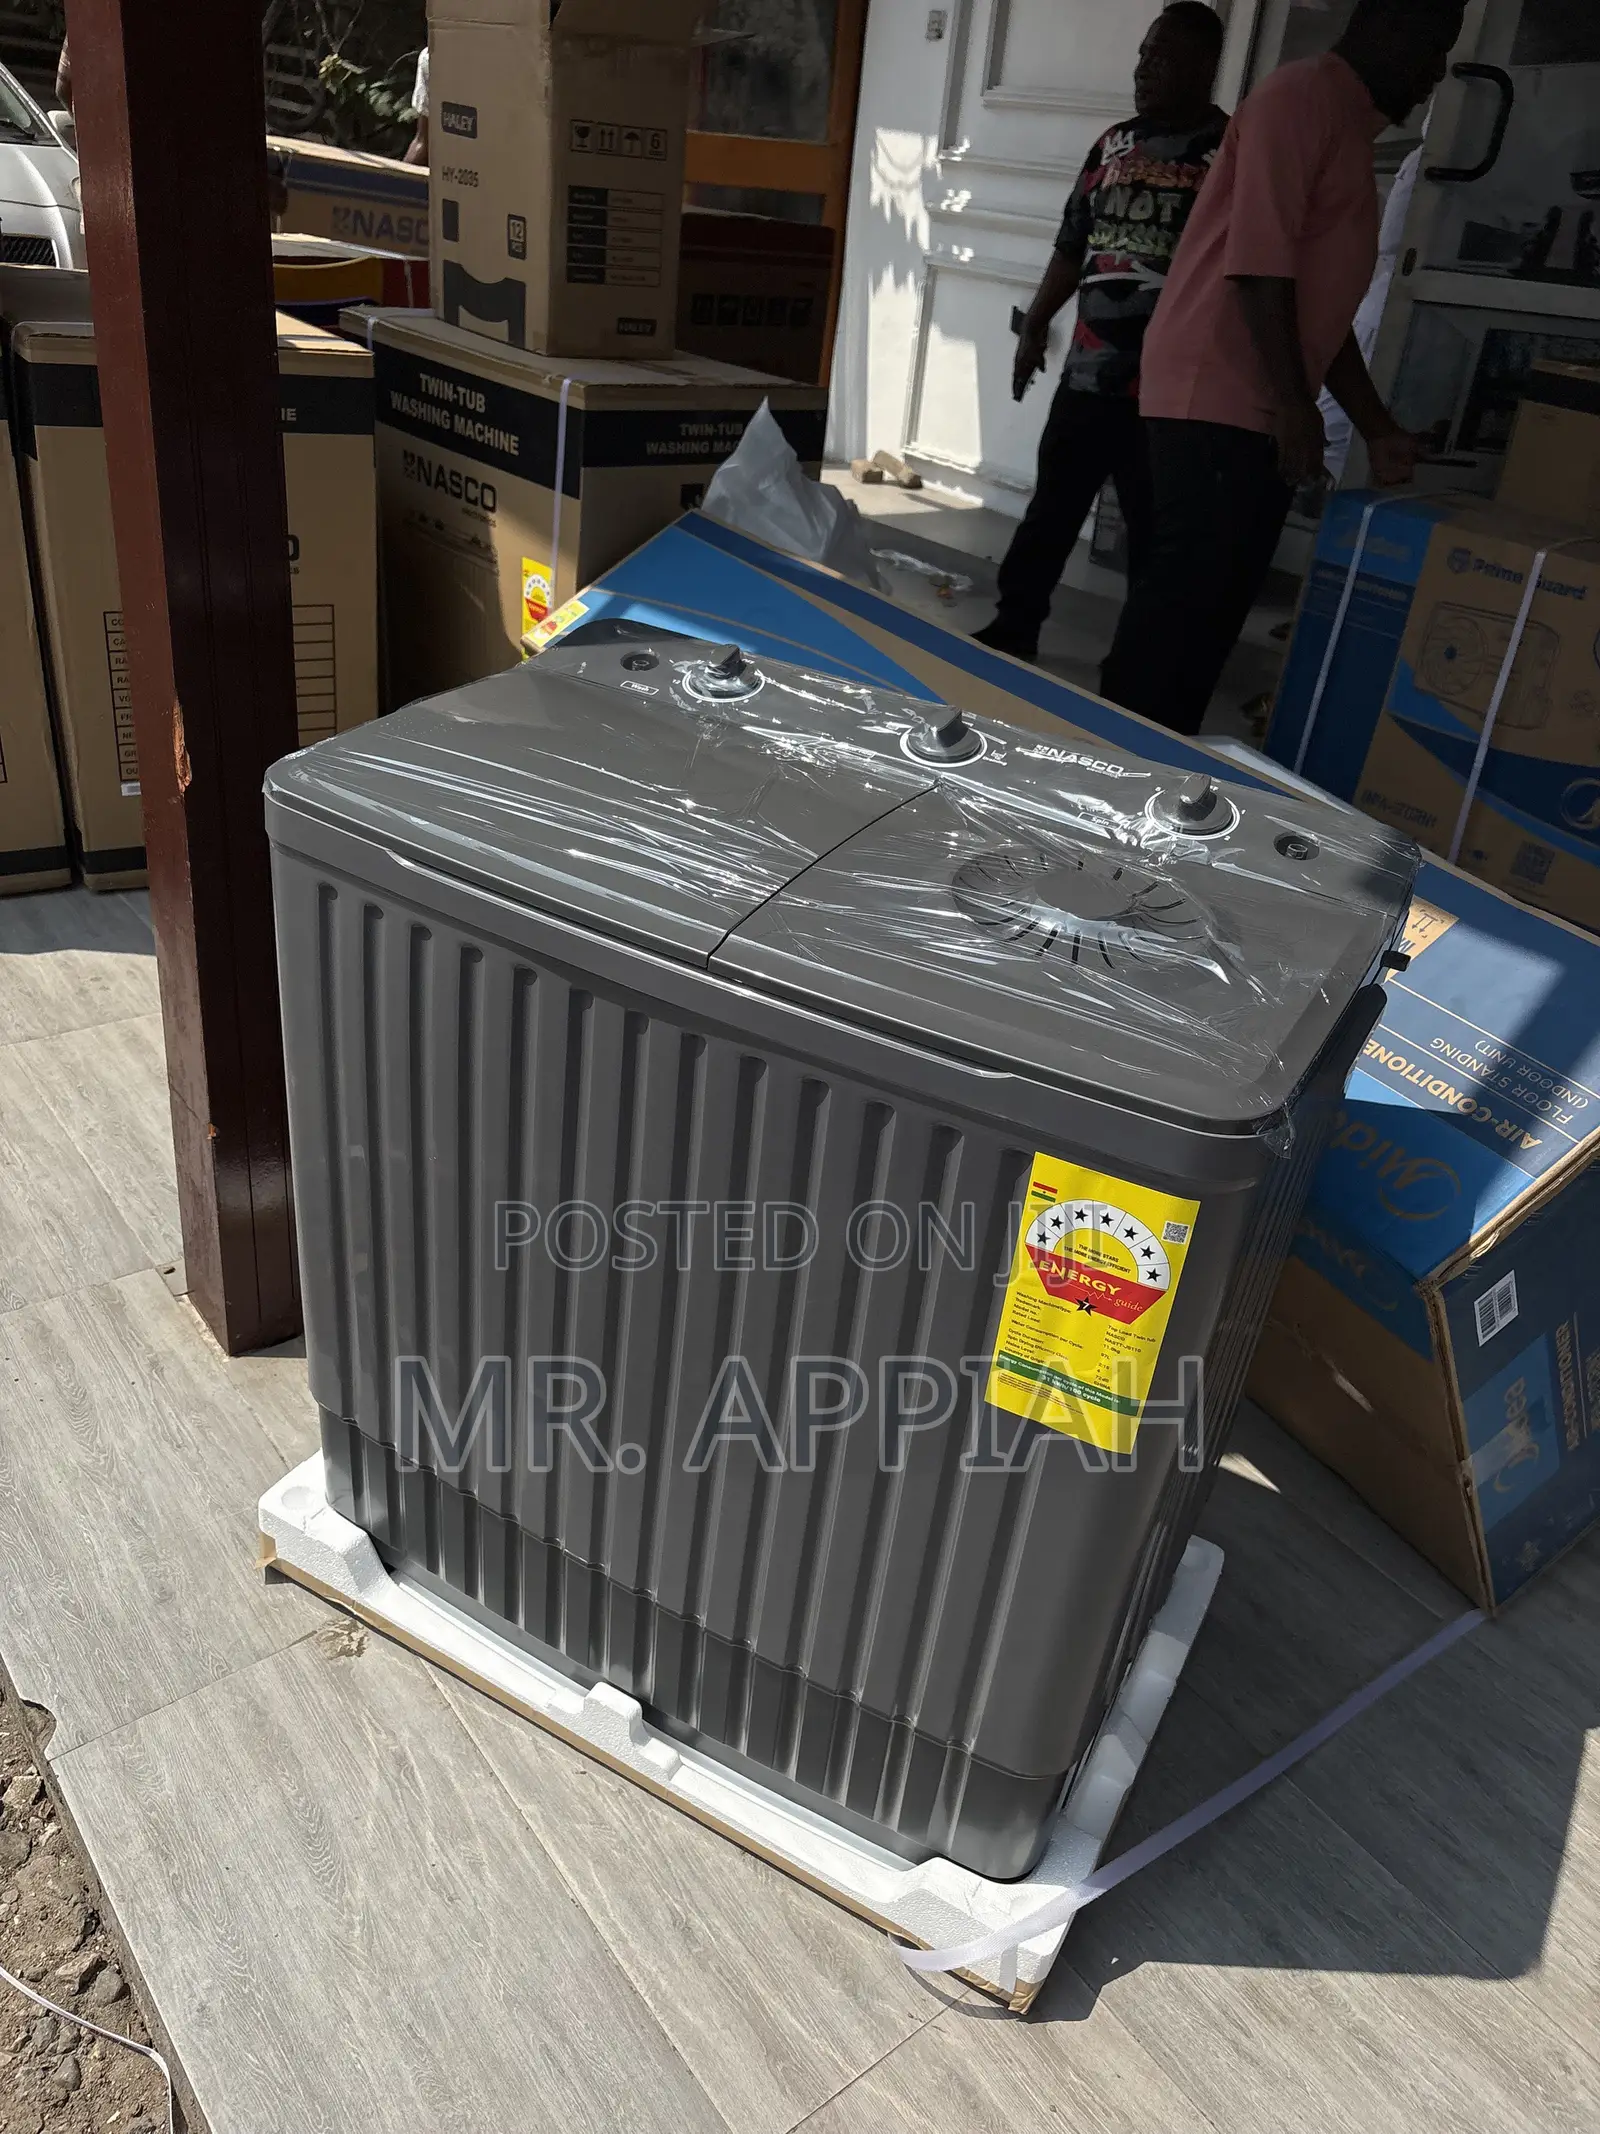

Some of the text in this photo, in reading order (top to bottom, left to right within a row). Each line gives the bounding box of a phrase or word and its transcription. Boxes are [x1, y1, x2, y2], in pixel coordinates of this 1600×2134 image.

[442, 111, 476, 132] HALEY
[442, 166, 478, 187] HY-2035
[352, 209, 428, 245] NASC
[420, 372, 487, 413] TWIN-TUB
[390, 390, 520, 457] WASHING MACHINE
[678, 423, 743, 437] TWIN-TUB
[646, 440, 710, 455] WASHING
[417, 456, 497, 513] NASCO
[1045, 747, 1125, 775] NASCO
[1091, 815, 1110, 827] Spin
[1429, 1037, 1574, 1125] FLOOR STANDING
[1475, 1040, 1589, 1109] (INDOOR UNIT)
[1362, 1038, 1544, 1151] AIR-CONDITIONE
[1074, 1249, 1088, 1259] MORE
[1106, 1261, 1131, 1274] EFFICIENT
[1078, 1243, 1088, 1251] THE
[1103, 1253, 1119, 1263] STARS
[1039, 1260, 1122, 1296] ENERGY
[1016, 1291, 1037, 1303] Washing
[1082, 1301, 1090, 1310] 7
[1114, 1297, 1143, 1312] guide
[1012, 1310, 1027, 1319] Rated
[1013, 1303, 1029, 1313] Model
[1008, 1328, 1022, 1337] Cycle
[1011, 1319, 1025, 1328] Water
[1026, 1324, 1059, 1339] Consumption
[1106, 1331, 1126, 1342] NASCO
[1107, 1325, 1118, 1333] Top
[1006, 1340, 1020, 1349] Noise
[1007, 1334, 1018, 1342] Spin
[1019, 1339, 1035, 1348] Drying
[1004, 1346, 1024, 1357] Country
[999, 1354, 1018, 1365] Energy
[1084, 1386, 1096, 1395] this
[1096, 1390, 1113, 1402] Model
[1082, 1391, 1102, 1403] cycle
